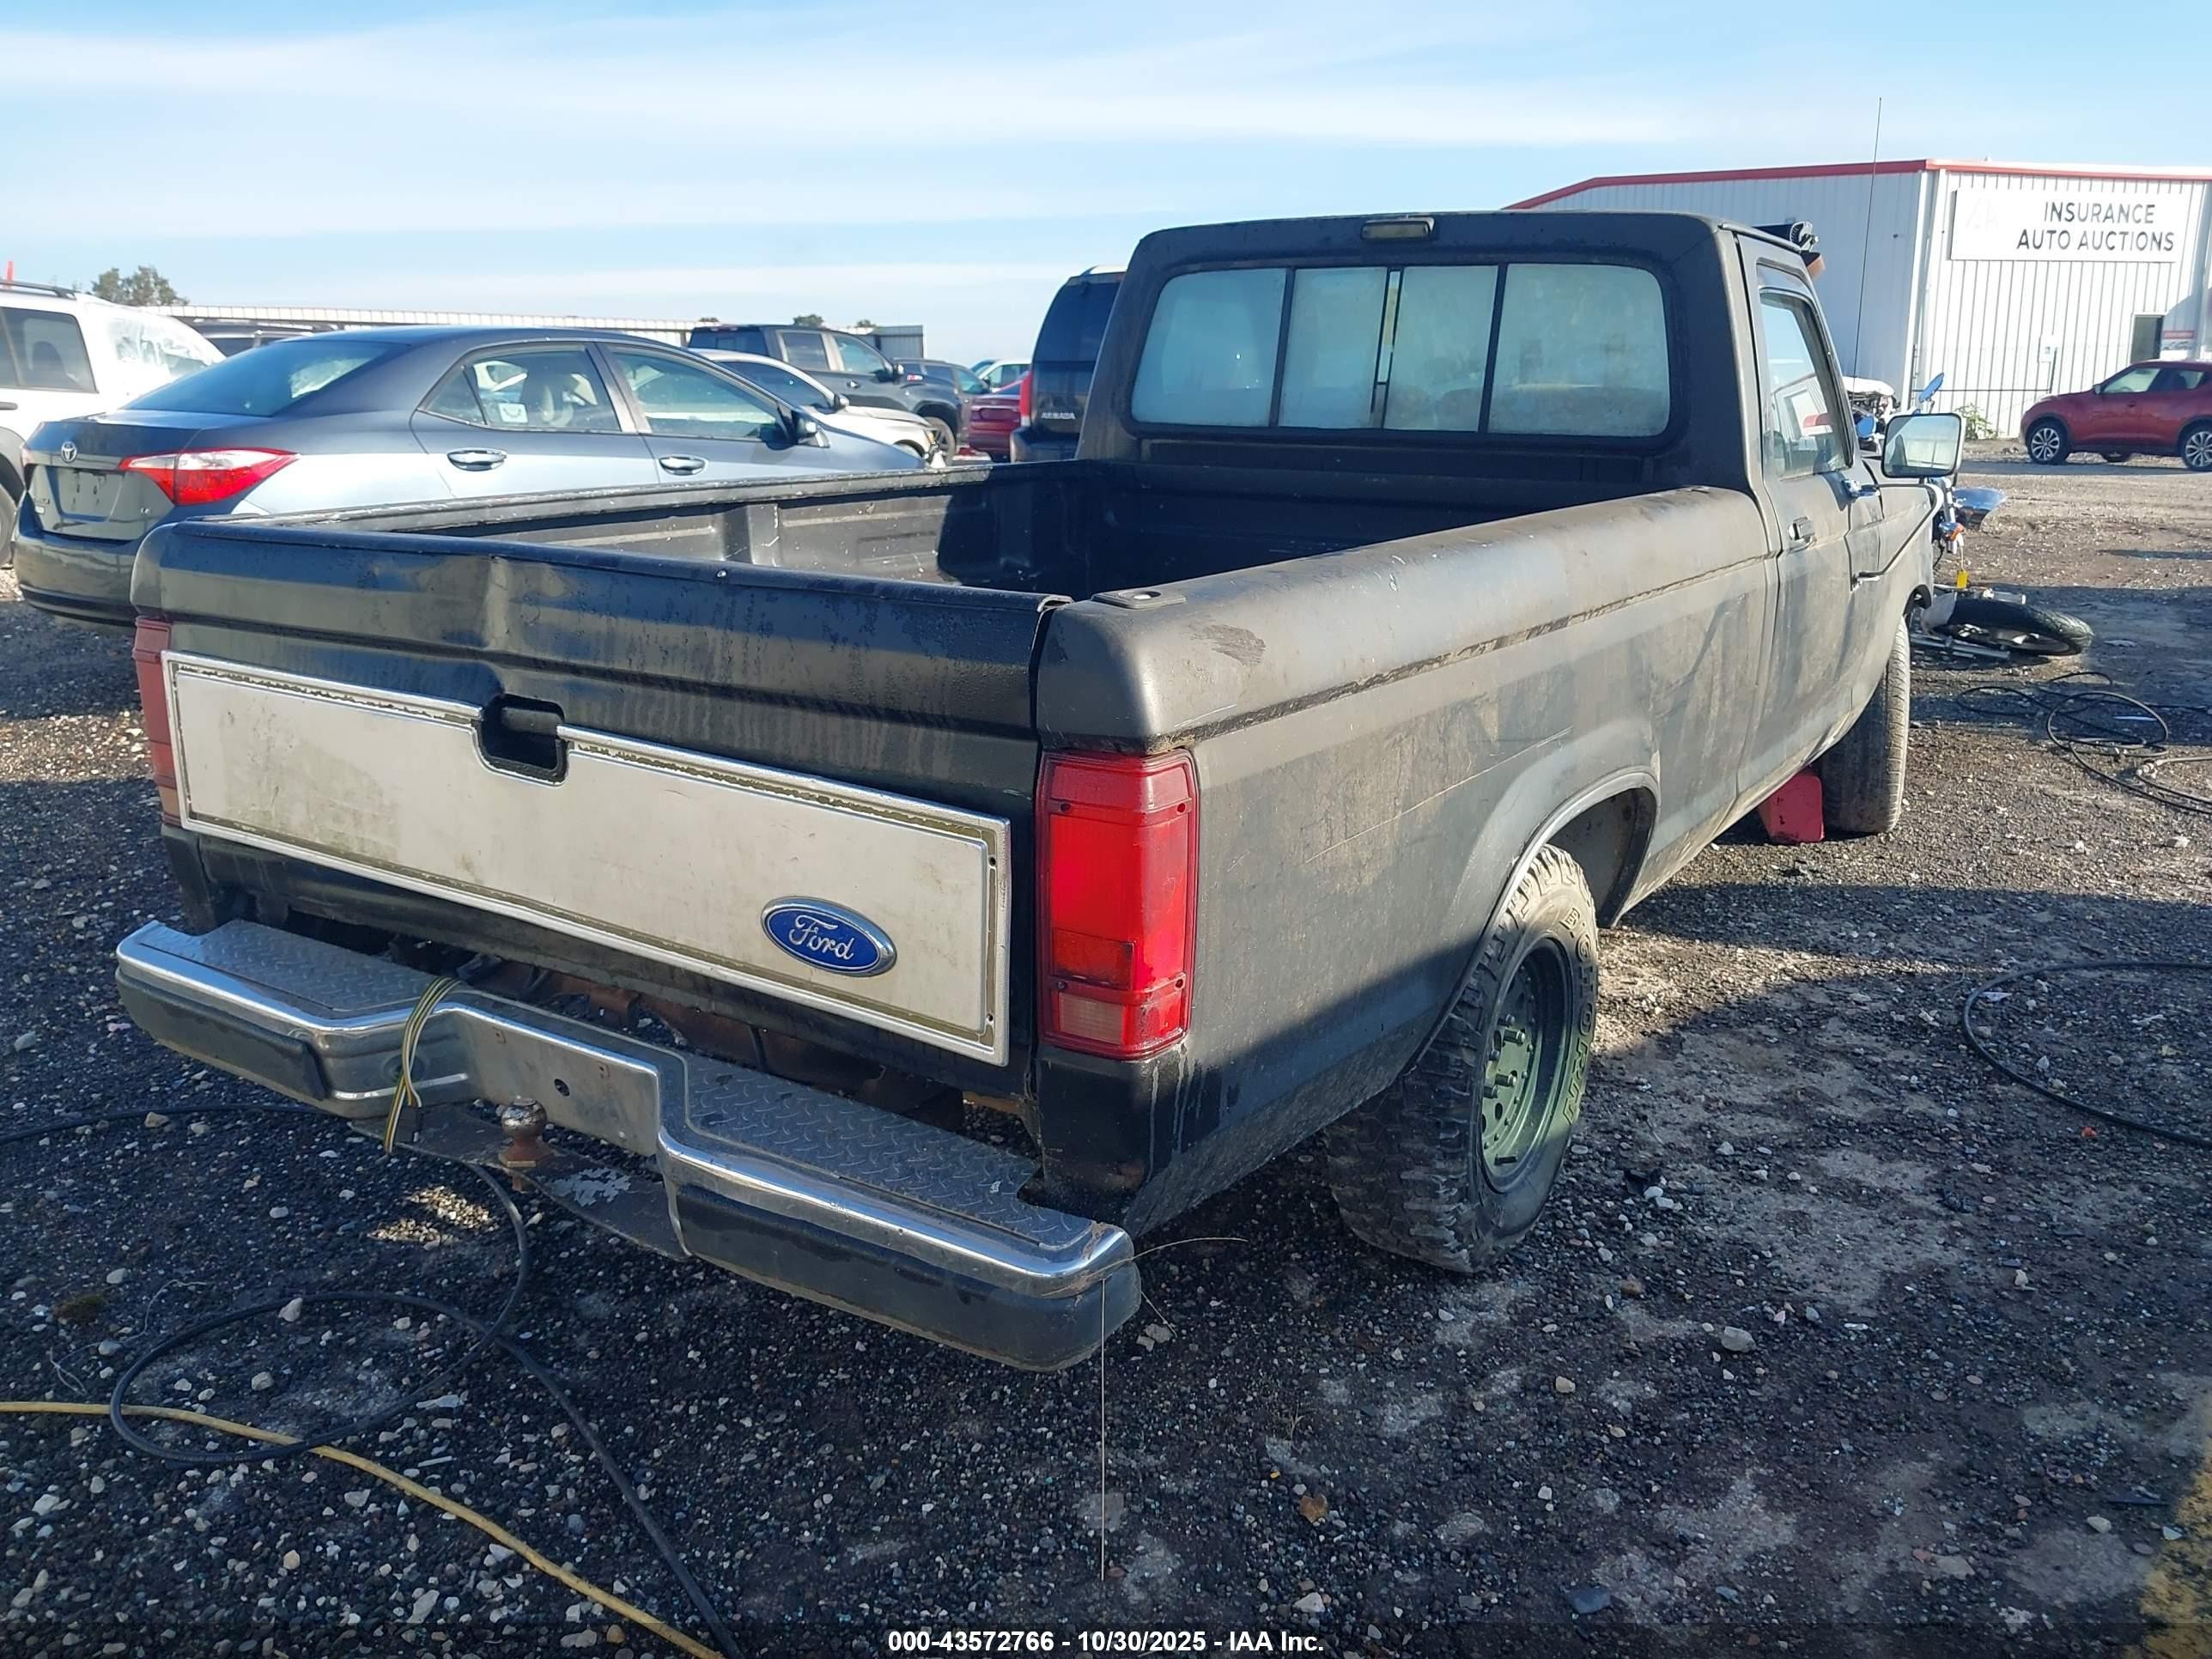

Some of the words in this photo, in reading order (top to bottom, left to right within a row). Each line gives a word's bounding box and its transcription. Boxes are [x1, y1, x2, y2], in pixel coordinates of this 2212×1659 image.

[2044, 201, 2156, 223] INSURANCE
[2016, 228, 2071, 250] AUTO
[2077, 230, 2175, 252] AUCTIONS
[788, 915, 854, 961] Ford
